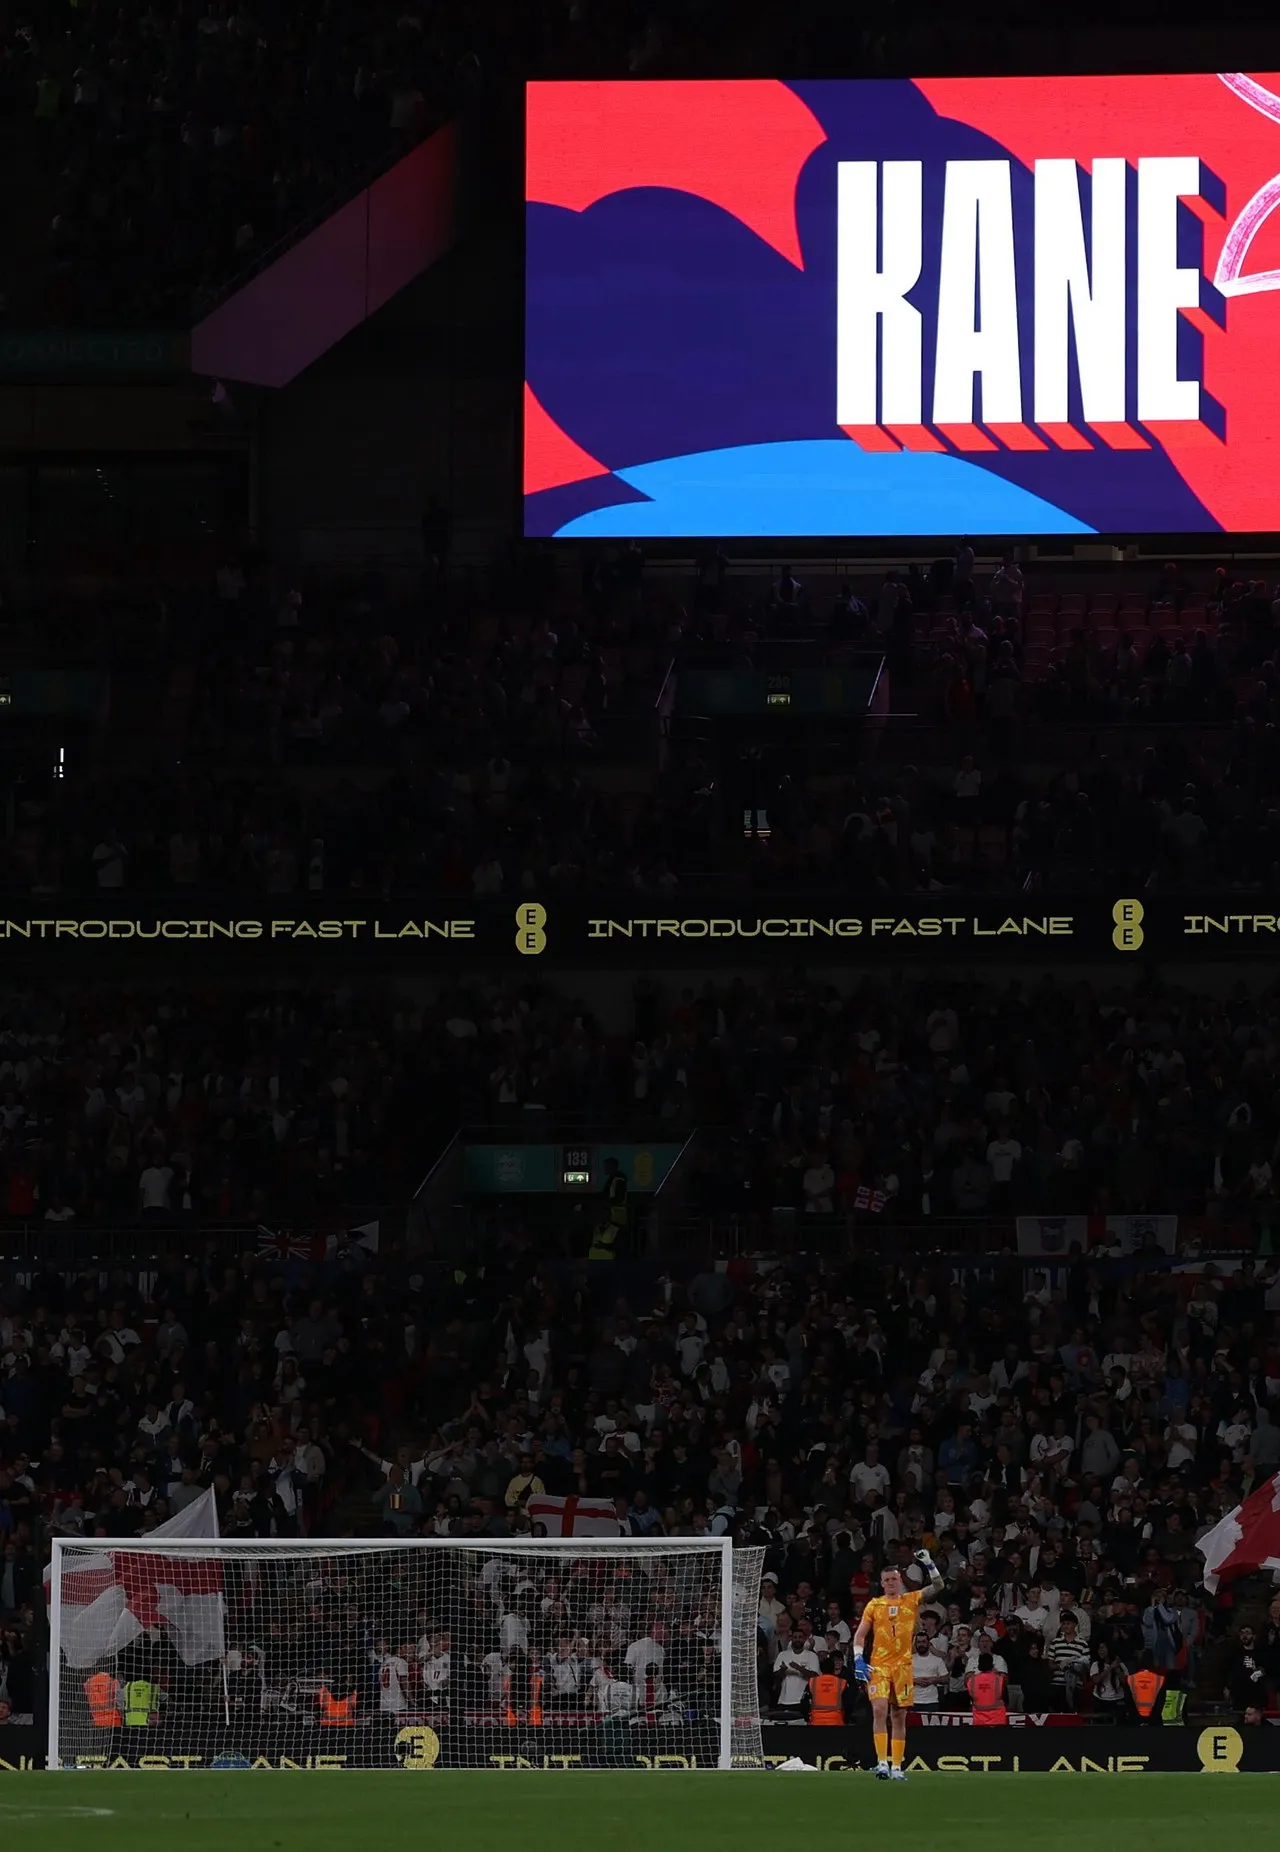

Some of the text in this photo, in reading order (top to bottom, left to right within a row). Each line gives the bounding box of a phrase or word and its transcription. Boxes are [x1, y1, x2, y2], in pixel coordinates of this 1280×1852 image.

[837, 157, 1199, 425] KANE
[272, 921, 366, 938] FAST
[375, 921, 475, 938] LANE
[589, 917, 1073, 938] INTRODUCING FAST LANE
[566, 1151, 588, 1167] 133
